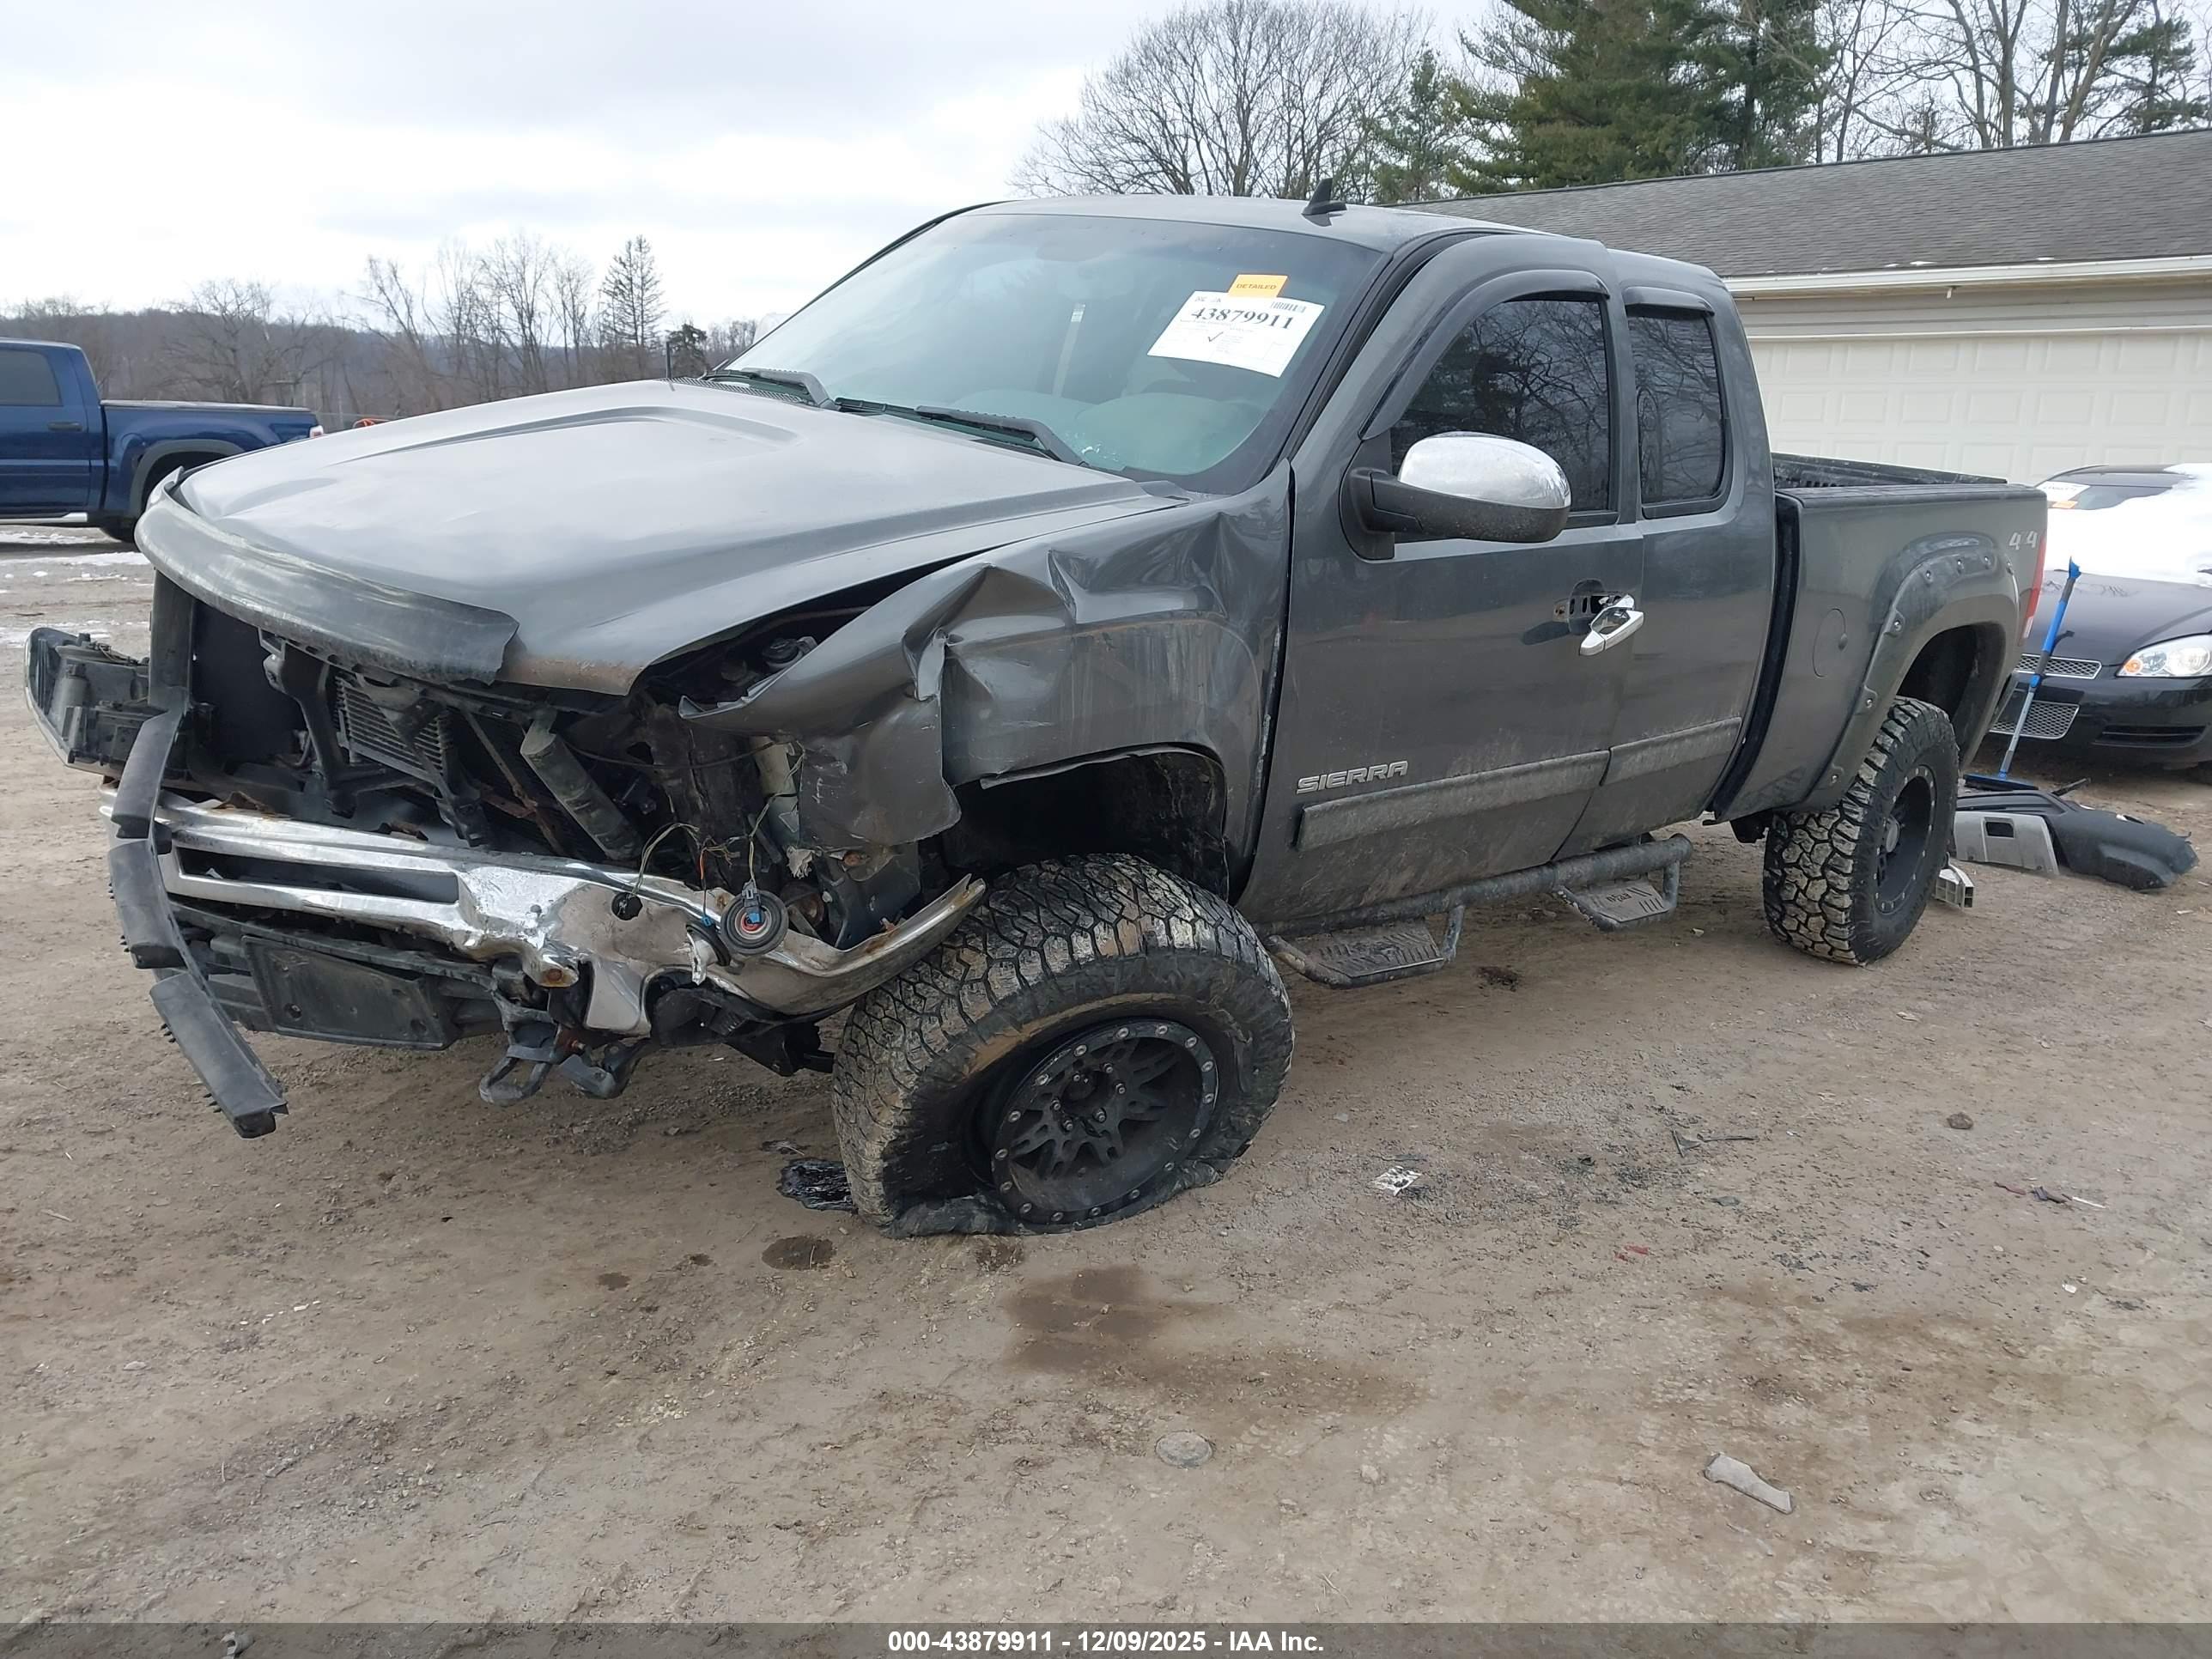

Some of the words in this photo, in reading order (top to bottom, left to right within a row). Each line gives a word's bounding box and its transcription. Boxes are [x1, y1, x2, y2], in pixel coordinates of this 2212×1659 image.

[1191, 307, 1293, 330] 43879911
[2009, 531, 2038, 550] 44
[1296, 760, 1408, 795] SIERRA
